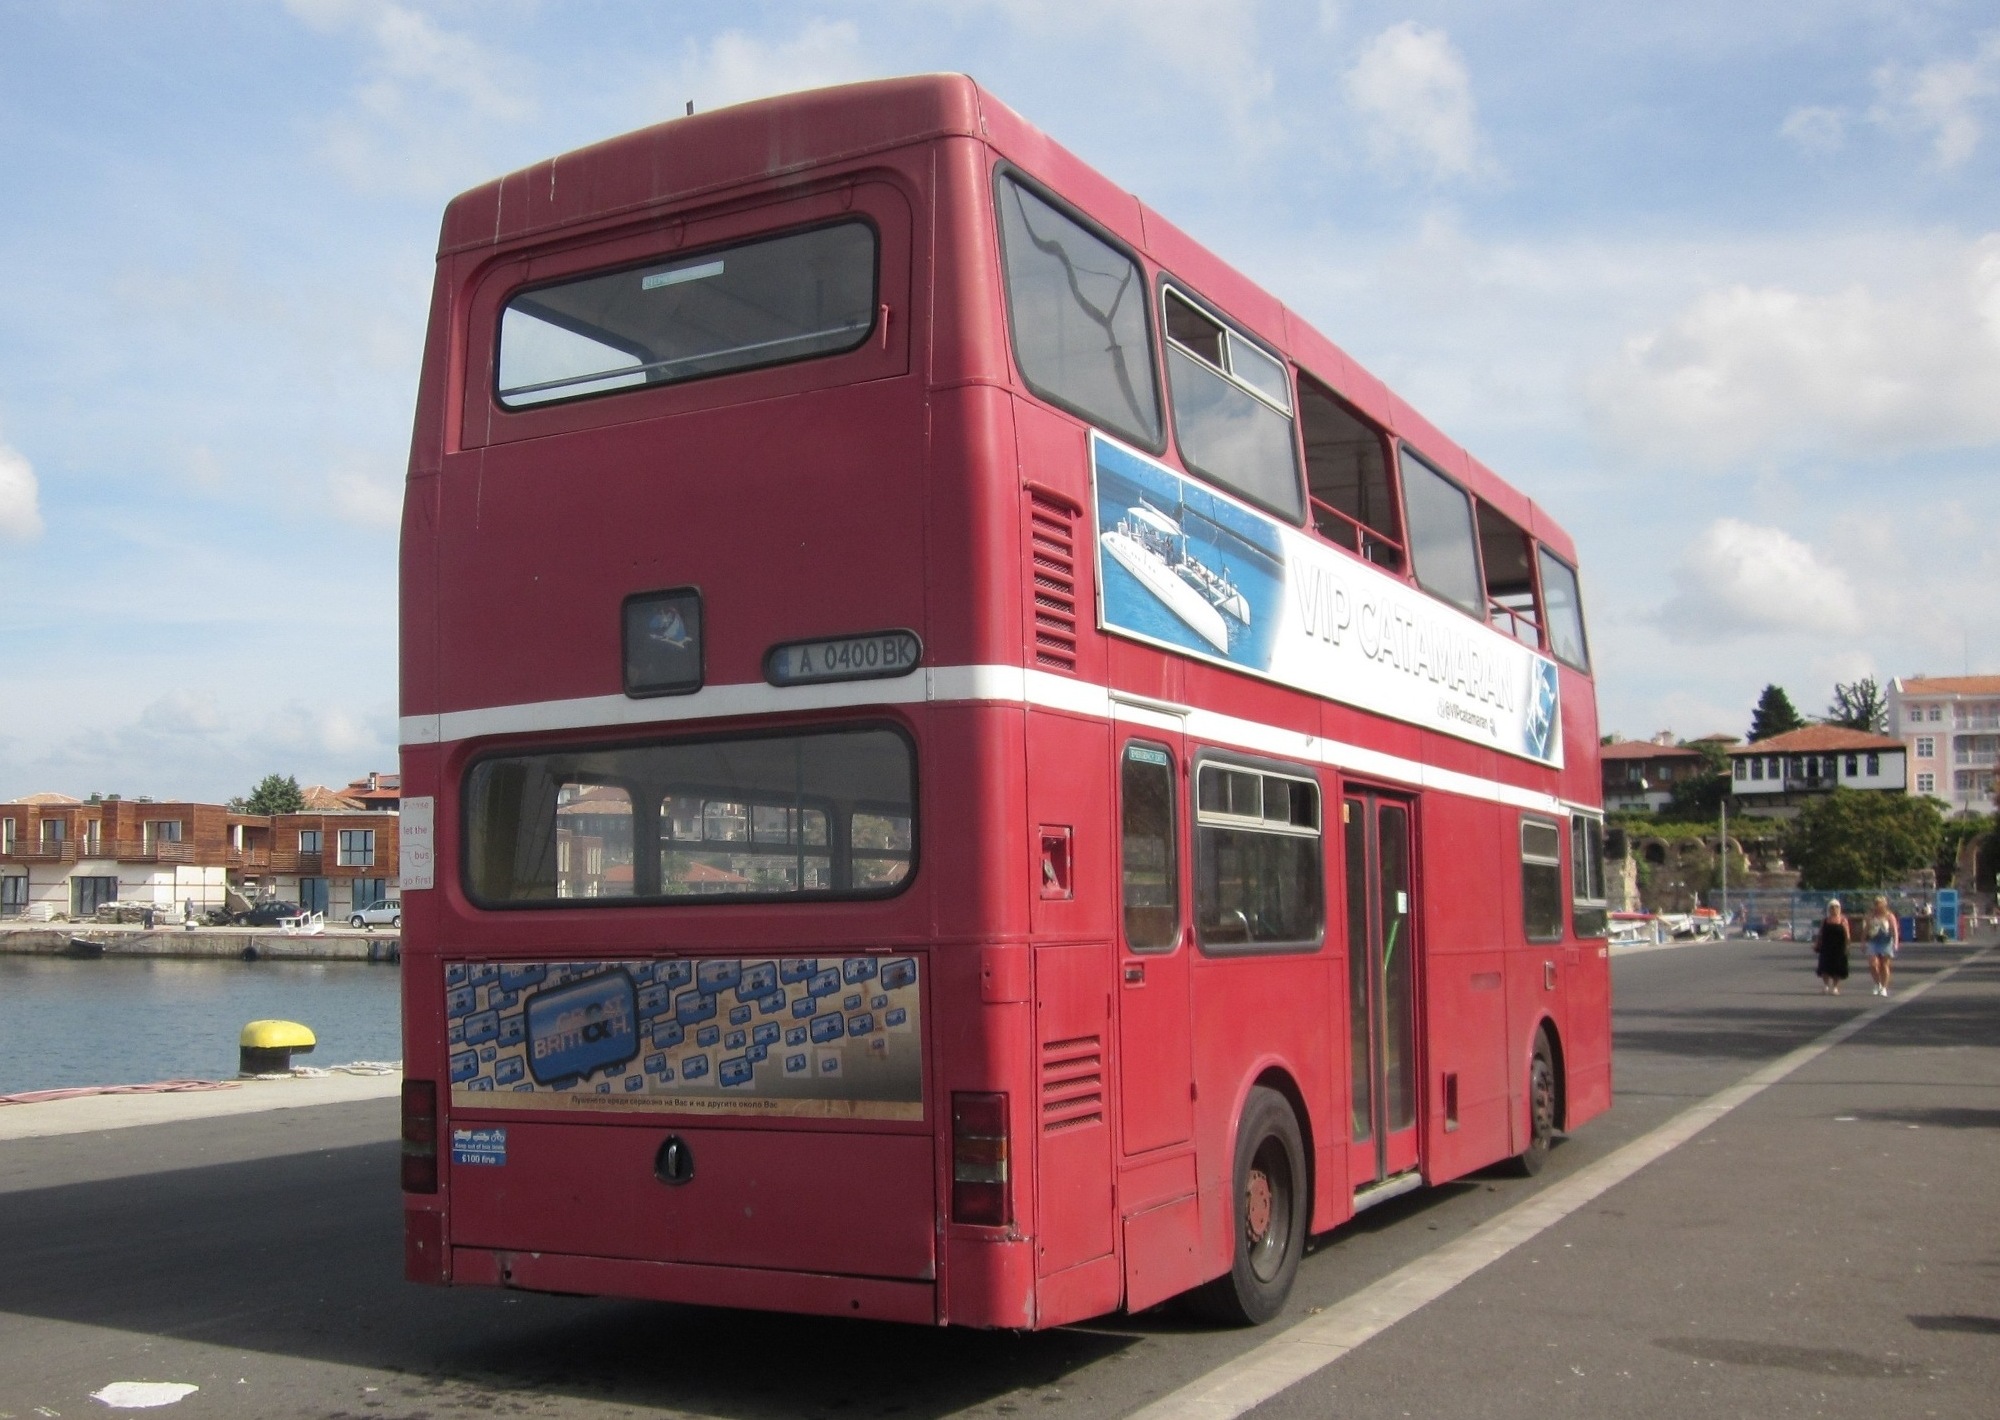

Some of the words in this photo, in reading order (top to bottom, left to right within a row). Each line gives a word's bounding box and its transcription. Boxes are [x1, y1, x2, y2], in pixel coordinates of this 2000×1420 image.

[1292, 556, 1350, 646] VIP
[1356, 588, 1514, 713] CATAMARAN
[799, 648, 812, 673] A
[824, 640, 879, 671] 0400
[882, 637, 914, 665] BK
[403, 826, 413, 835] let
[415, 825, 428, 834] the
[414, 851, 430, 860] bus
[403, 878, 412, 886] go
[415, 875, 431, 885] first
[674, 1098, 688, 1107] Вас
[764, 1100, 778, 1109] Вас
[461, 1154, 480, 1163] £100
[481, 1155, 496, 1164] fine
